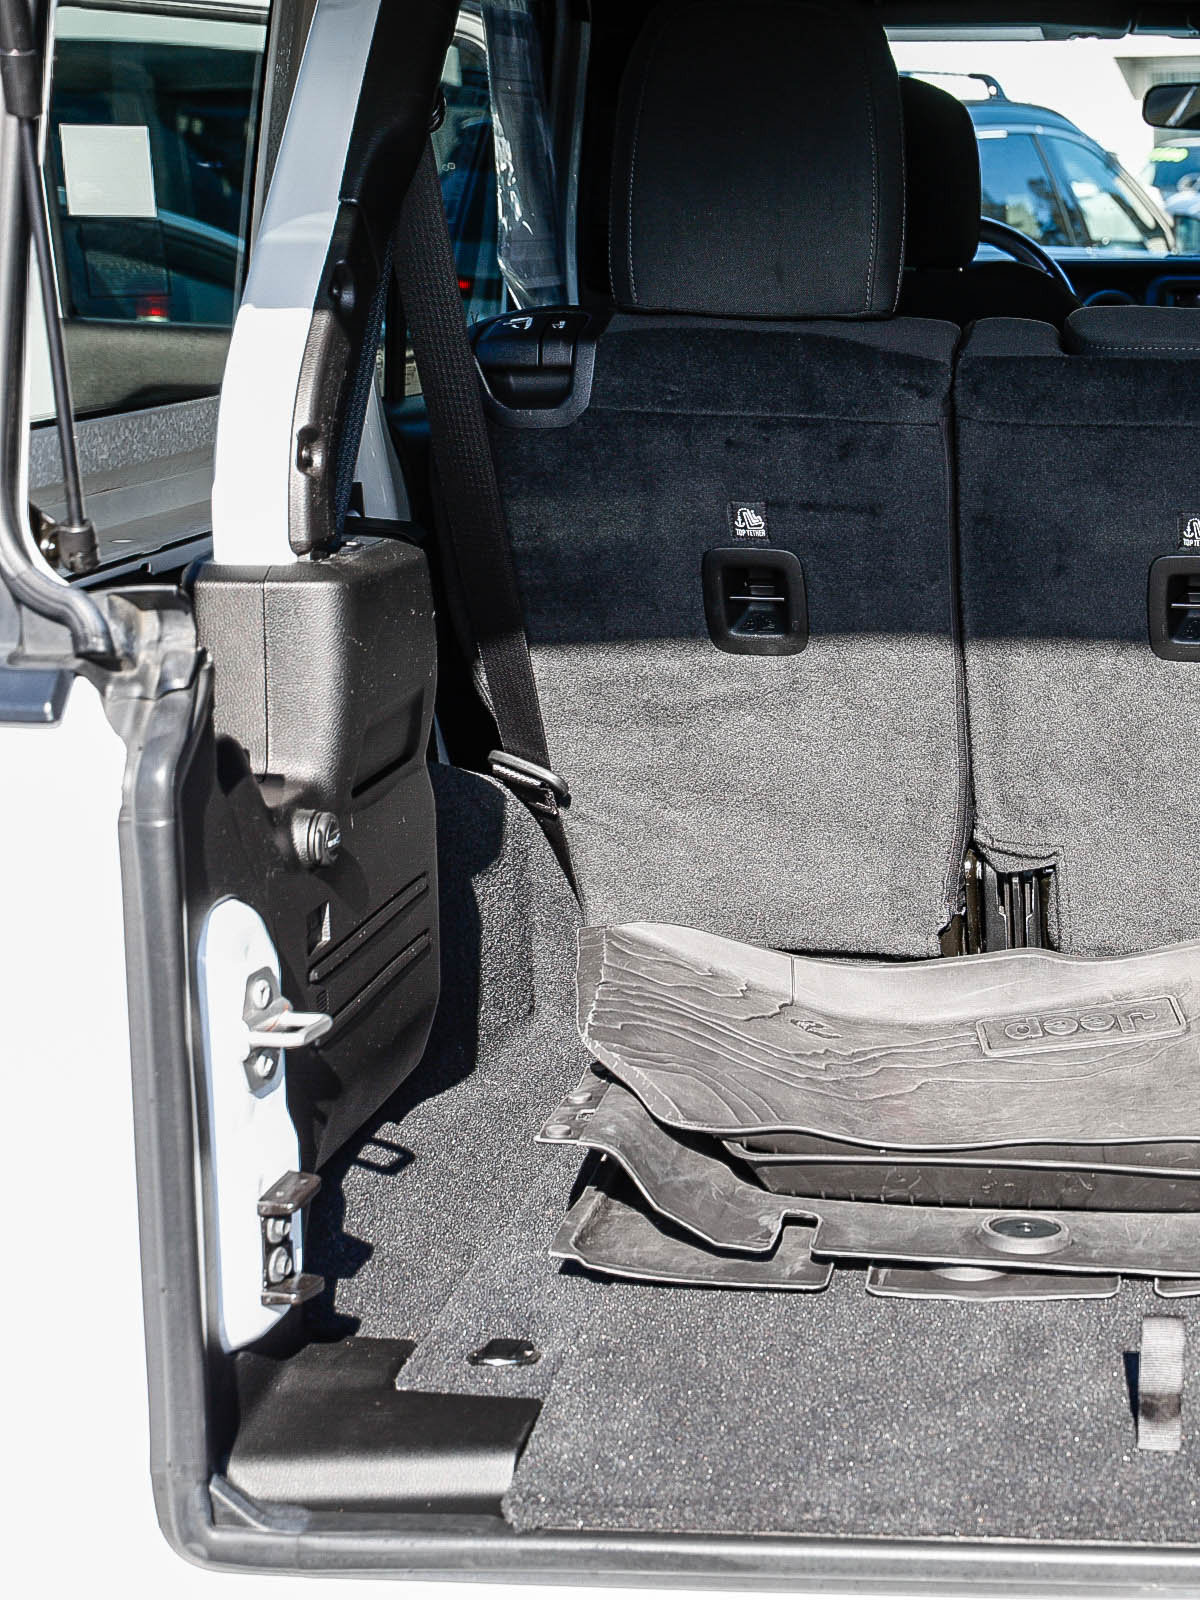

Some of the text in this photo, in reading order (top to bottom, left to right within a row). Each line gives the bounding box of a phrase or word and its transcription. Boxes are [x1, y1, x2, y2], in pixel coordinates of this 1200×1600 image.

[735, 528, 766, 537] TOP TETHER
[1183, 538, 1194, 546] TOP
[1004, 1007, 1157, 1041] Jeep
